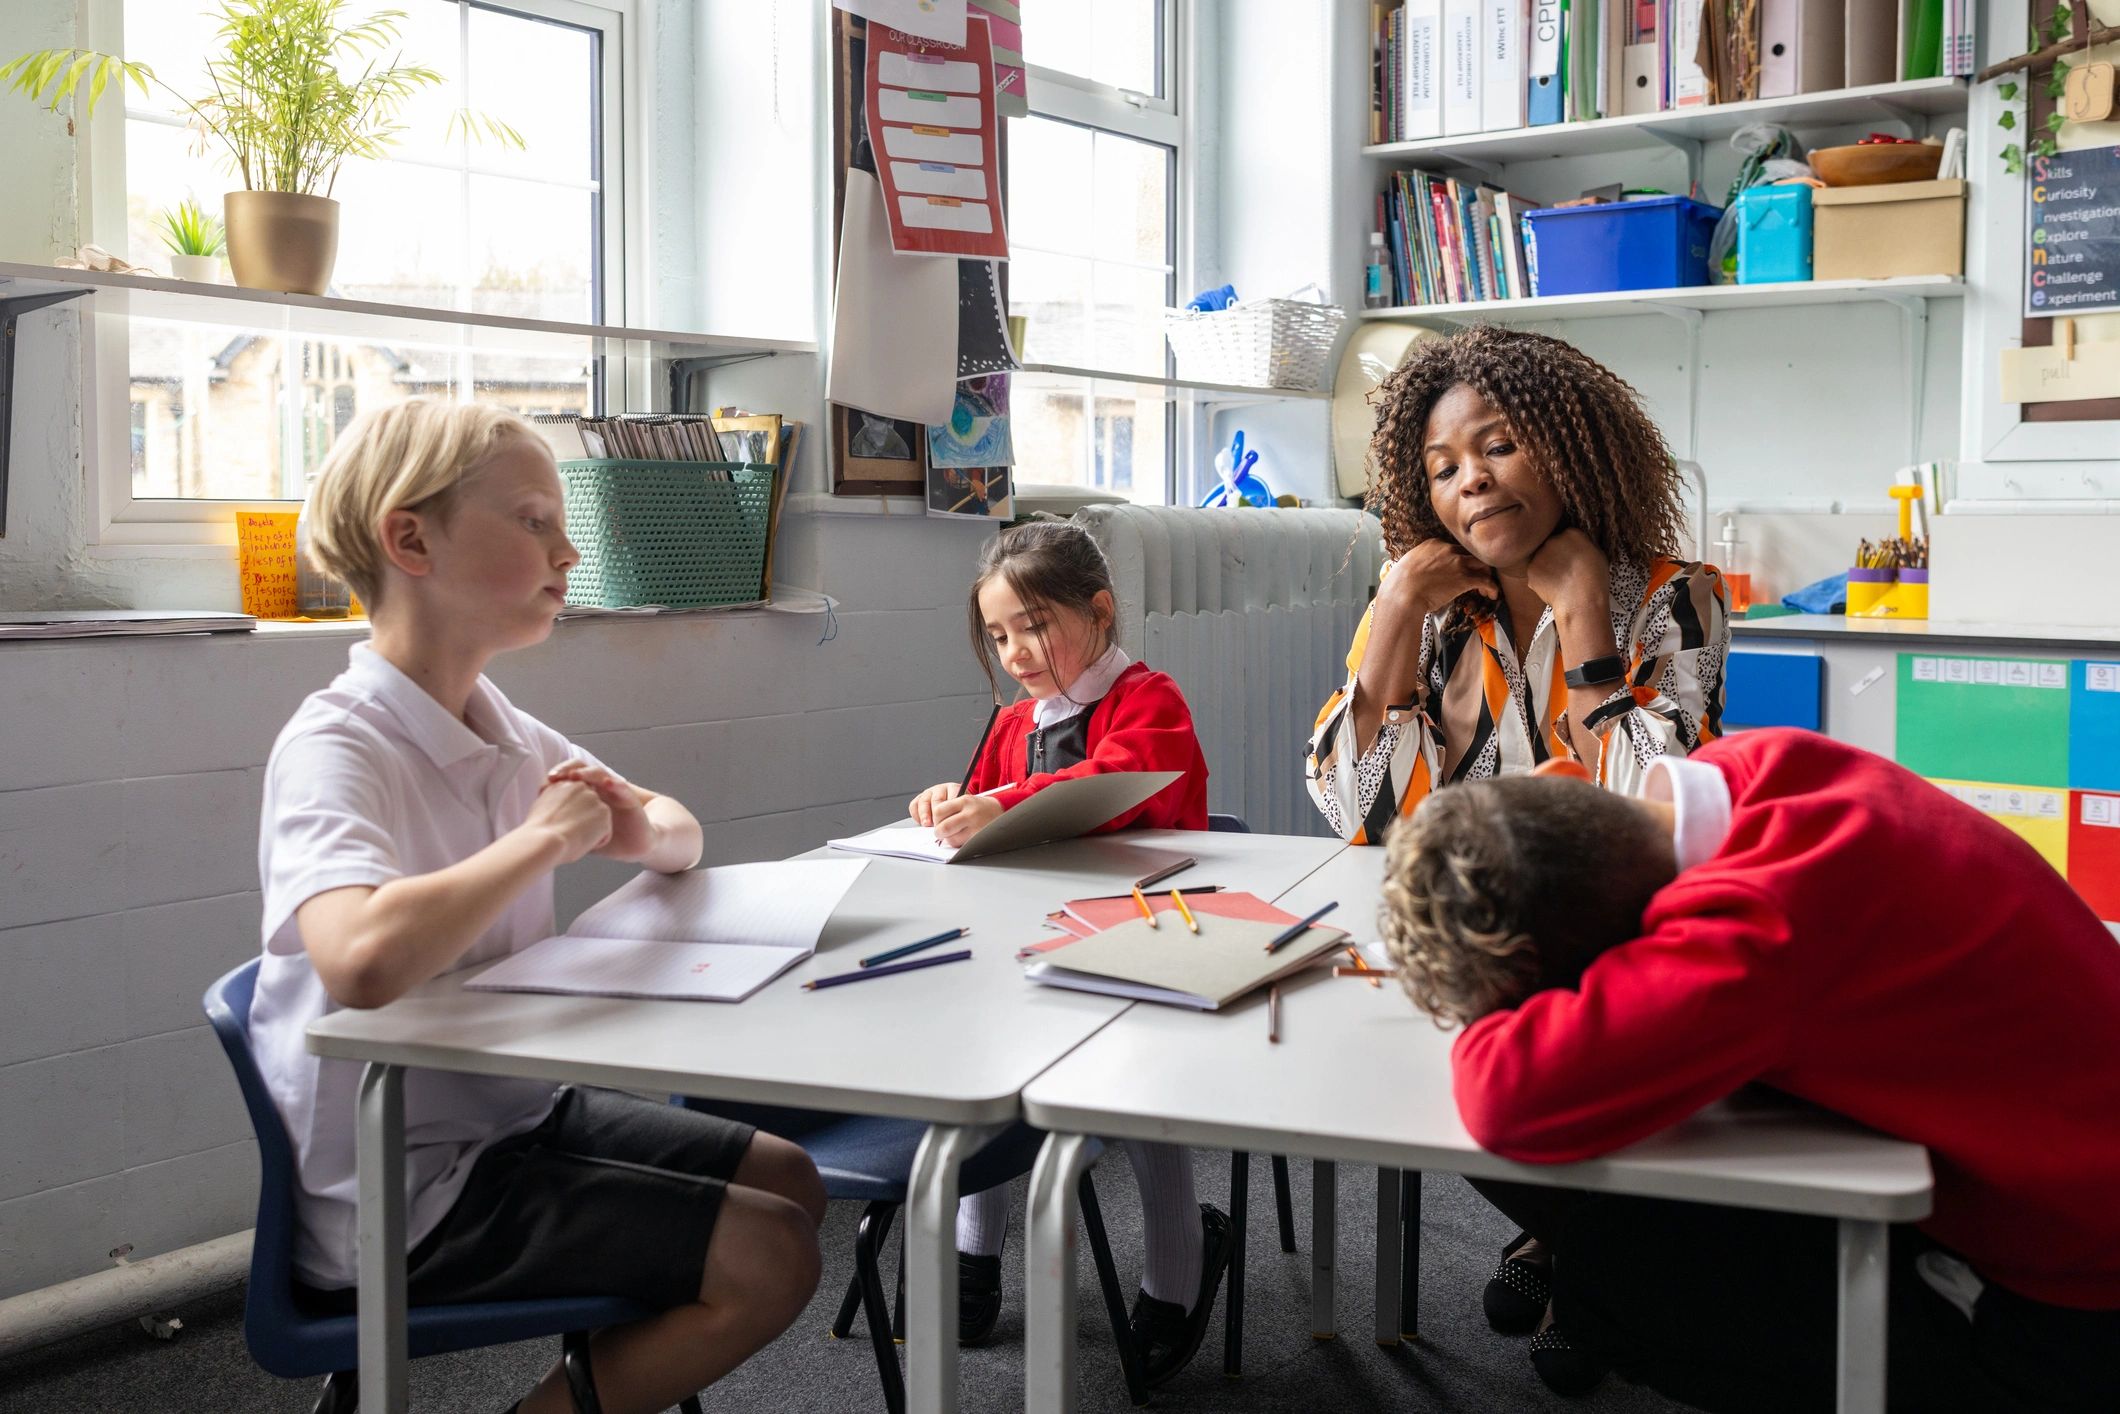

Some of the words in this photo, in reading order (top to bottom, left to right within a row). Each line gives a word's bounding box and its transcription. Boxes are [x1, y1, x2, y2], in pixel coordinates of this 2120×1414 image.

[1497, 7, 1505, 25] FTT
[889, 30, 905, 44] OUR
[1412, 29, 1420, 81] LEADERSHIP
[1423, 41, 1431, 99] CURRICULUM
[1412, 82, 1420, 98] FILE
[2034, 156, 2073, 182] Skills
[2033, 228, 2089, 245] explore
[2033, 248, 2084, 266] nature
